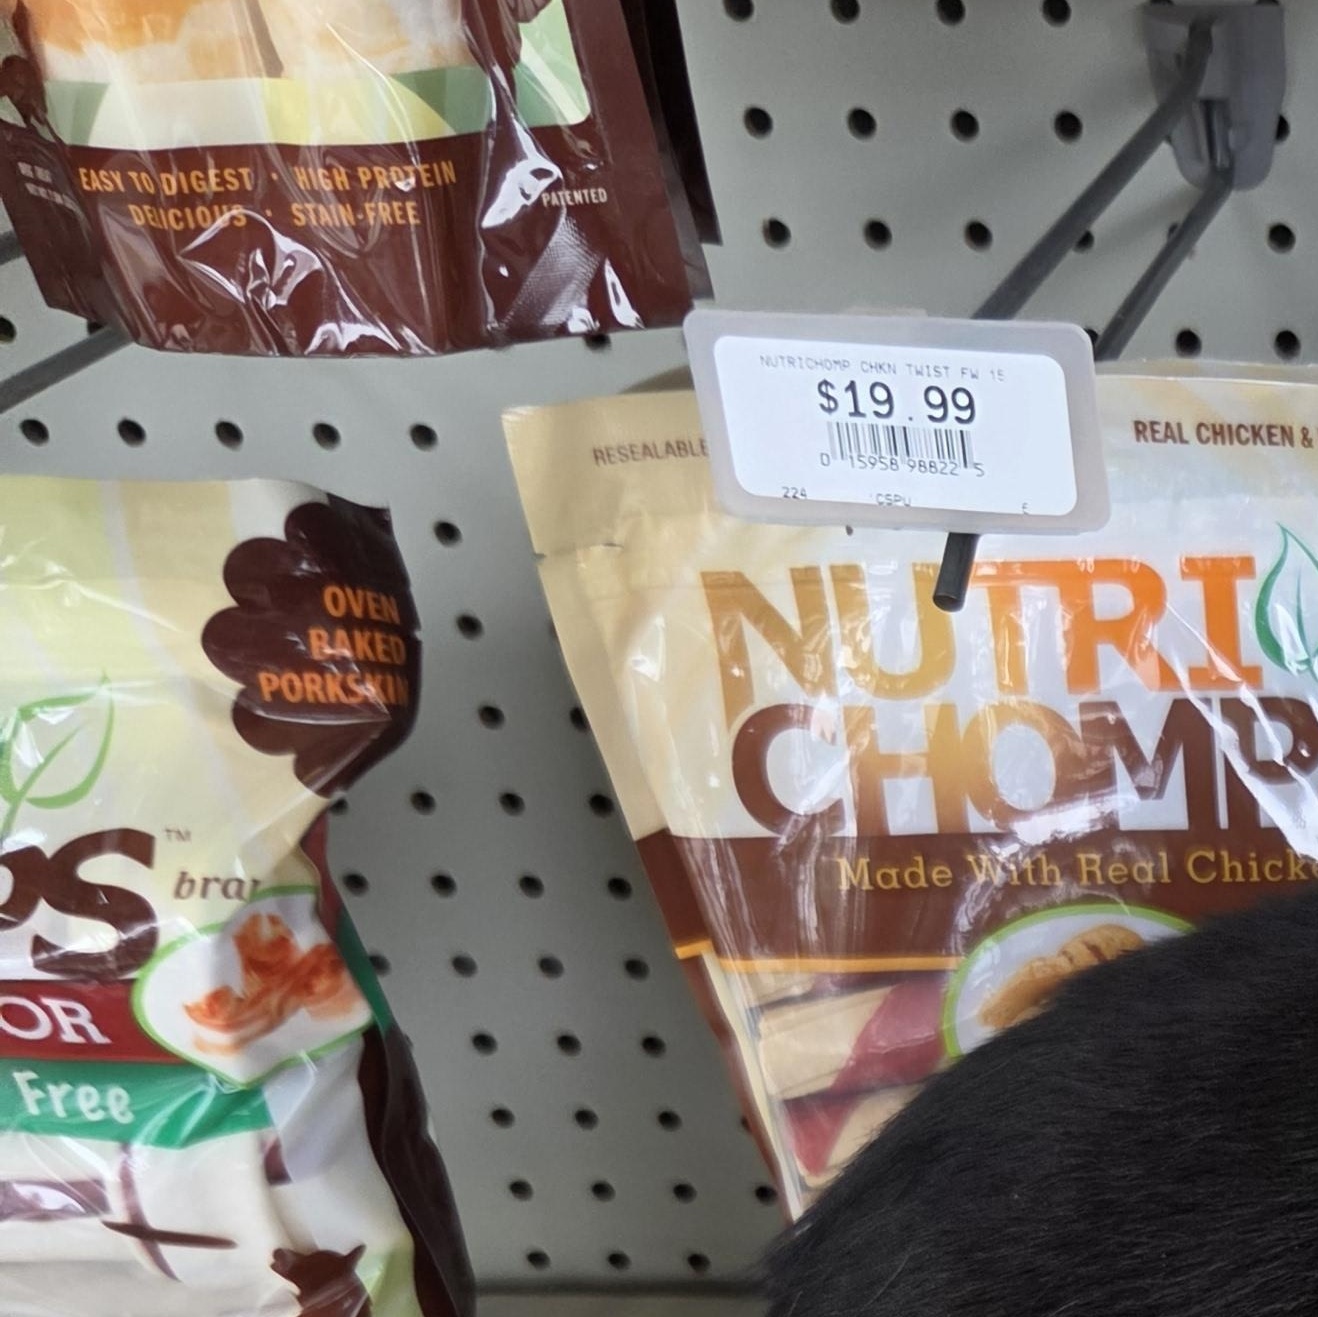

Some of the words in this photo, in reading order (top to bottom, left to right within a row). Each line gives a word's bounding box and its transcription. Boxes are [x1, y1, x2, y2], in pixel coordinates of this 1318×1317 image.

[78, 167, 124, 193] EASY
[128, 169, 155, 195] TO
[162, 166, 253, 197] DIGEST
[294, 165, 349, 192] HIGH
[358, 160, 457, 190] PROTEIN
[128, 203, 247, 231] DELICIOUS
[292, 201, 422, 228] STAIN-FREE
[541, 188, 608, 208] PATENTED
[760, 355, 851, 373] NUTRICHOMP
[861, 361, 897, 376] CHKN
[906, 364, 952, 380] TWIST
[961, 367, 980, 382] FW
[816, 377, 977, 425] $19.99
[593, 437, 711, 467] RESEALABLE
[1133, 420, 1190, 445] REAL
[1196, 421, 1295, 449] CHICKEN
[1300, 428, 1314, 449] &
[848, 454, 900, 472] 15958
[907, 457, 960, 476] 98822
[323, 585, 400, 625] OVEN
[308, 626, 406, 667] BAKED
[700, 555, 1264, 708] NUTRI
[258, 672, 409, 707] PORKSKIN
[836, 855, 953, 889] Made
[967, 854, 1062, 886] With
[1076, 851, 1170, 886] Real
[13, 1071, 134, 1124] Free
